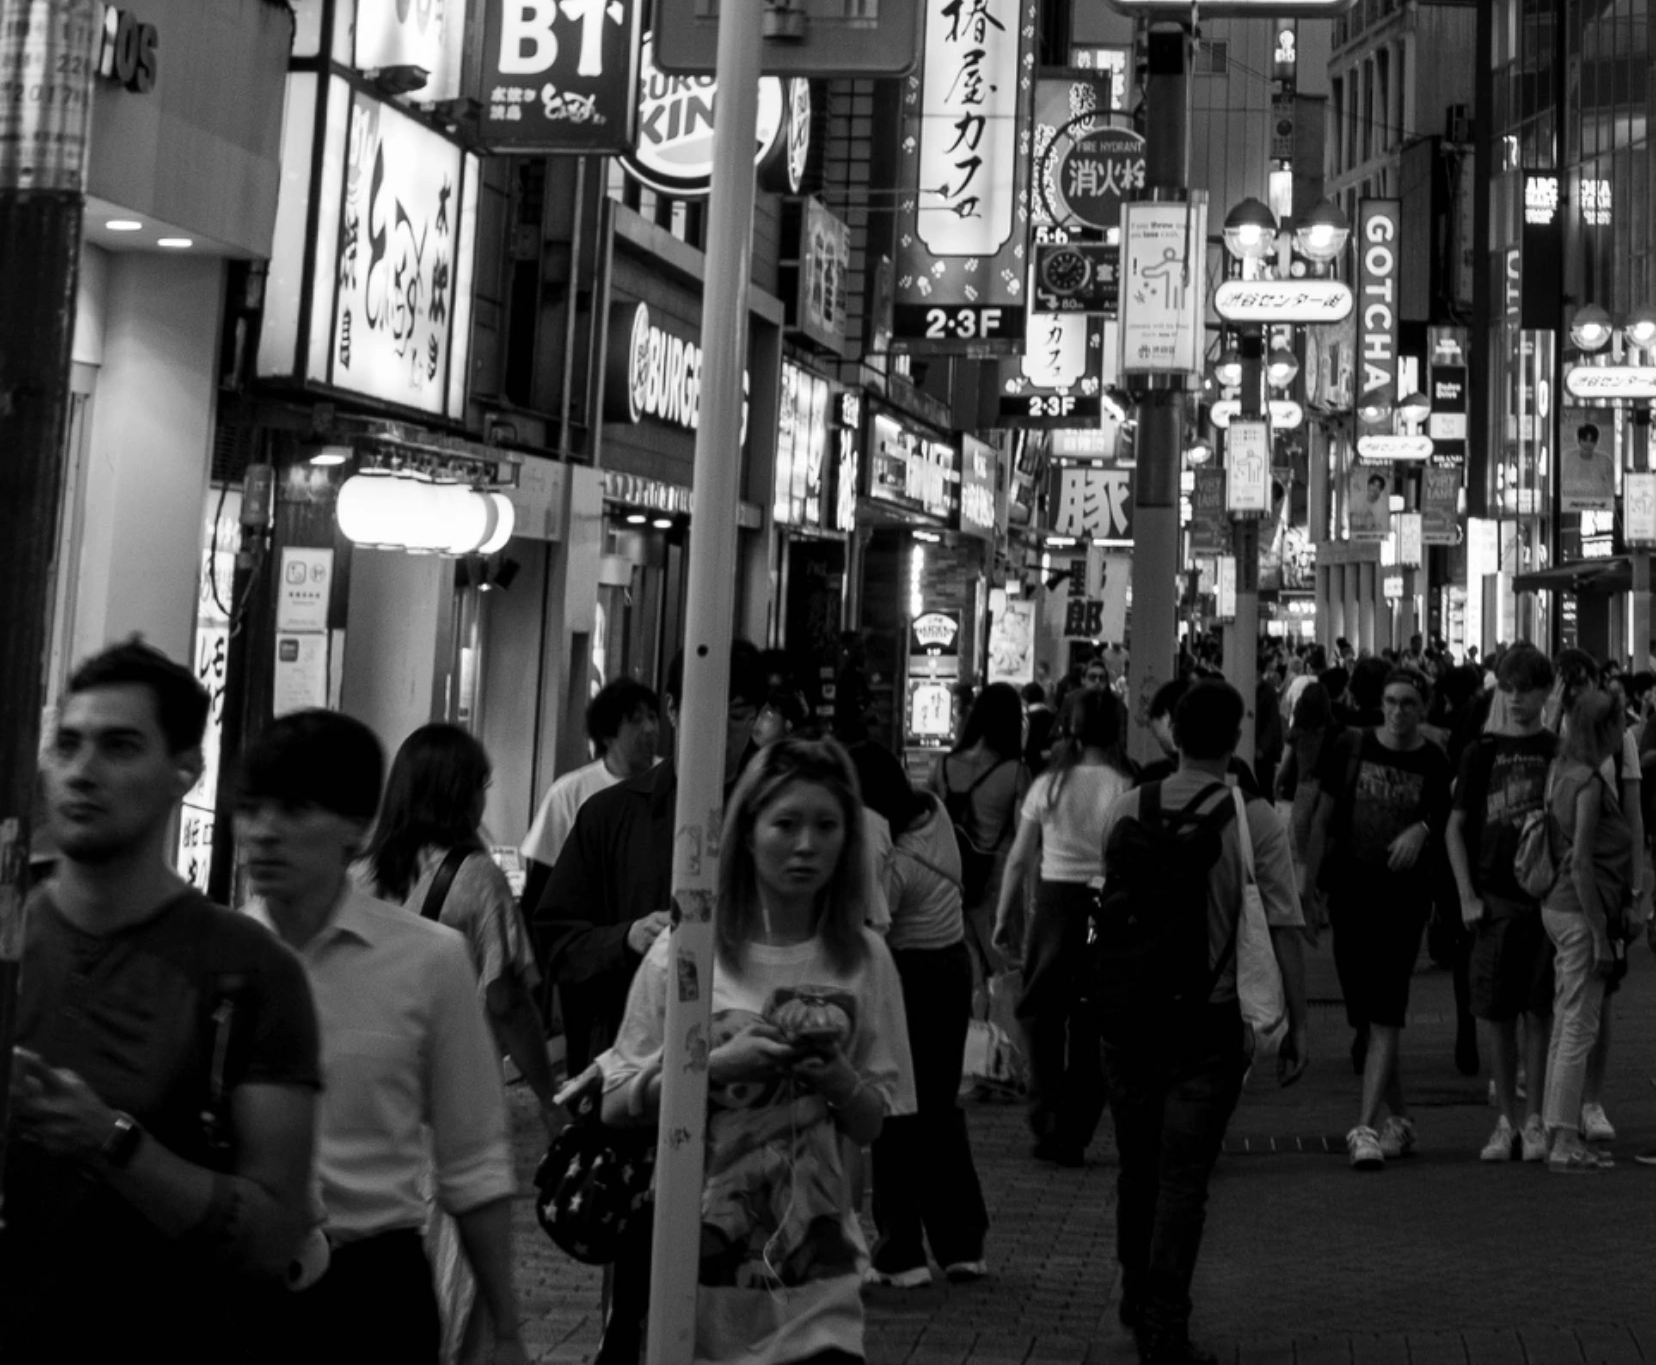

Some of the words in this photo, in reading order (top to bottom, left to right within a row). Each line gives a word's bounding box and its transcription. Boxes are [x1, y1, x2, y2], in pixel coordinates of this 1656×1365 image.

[640, 95, 718, 144] KIN
[1075, 140, 1099, 153] FIRE
[1100, 140, 1142, 153] HYDRANT
[1363, 215, 1395, 392] GOTCHA
[1055, 469, 1132, 538] 豚
